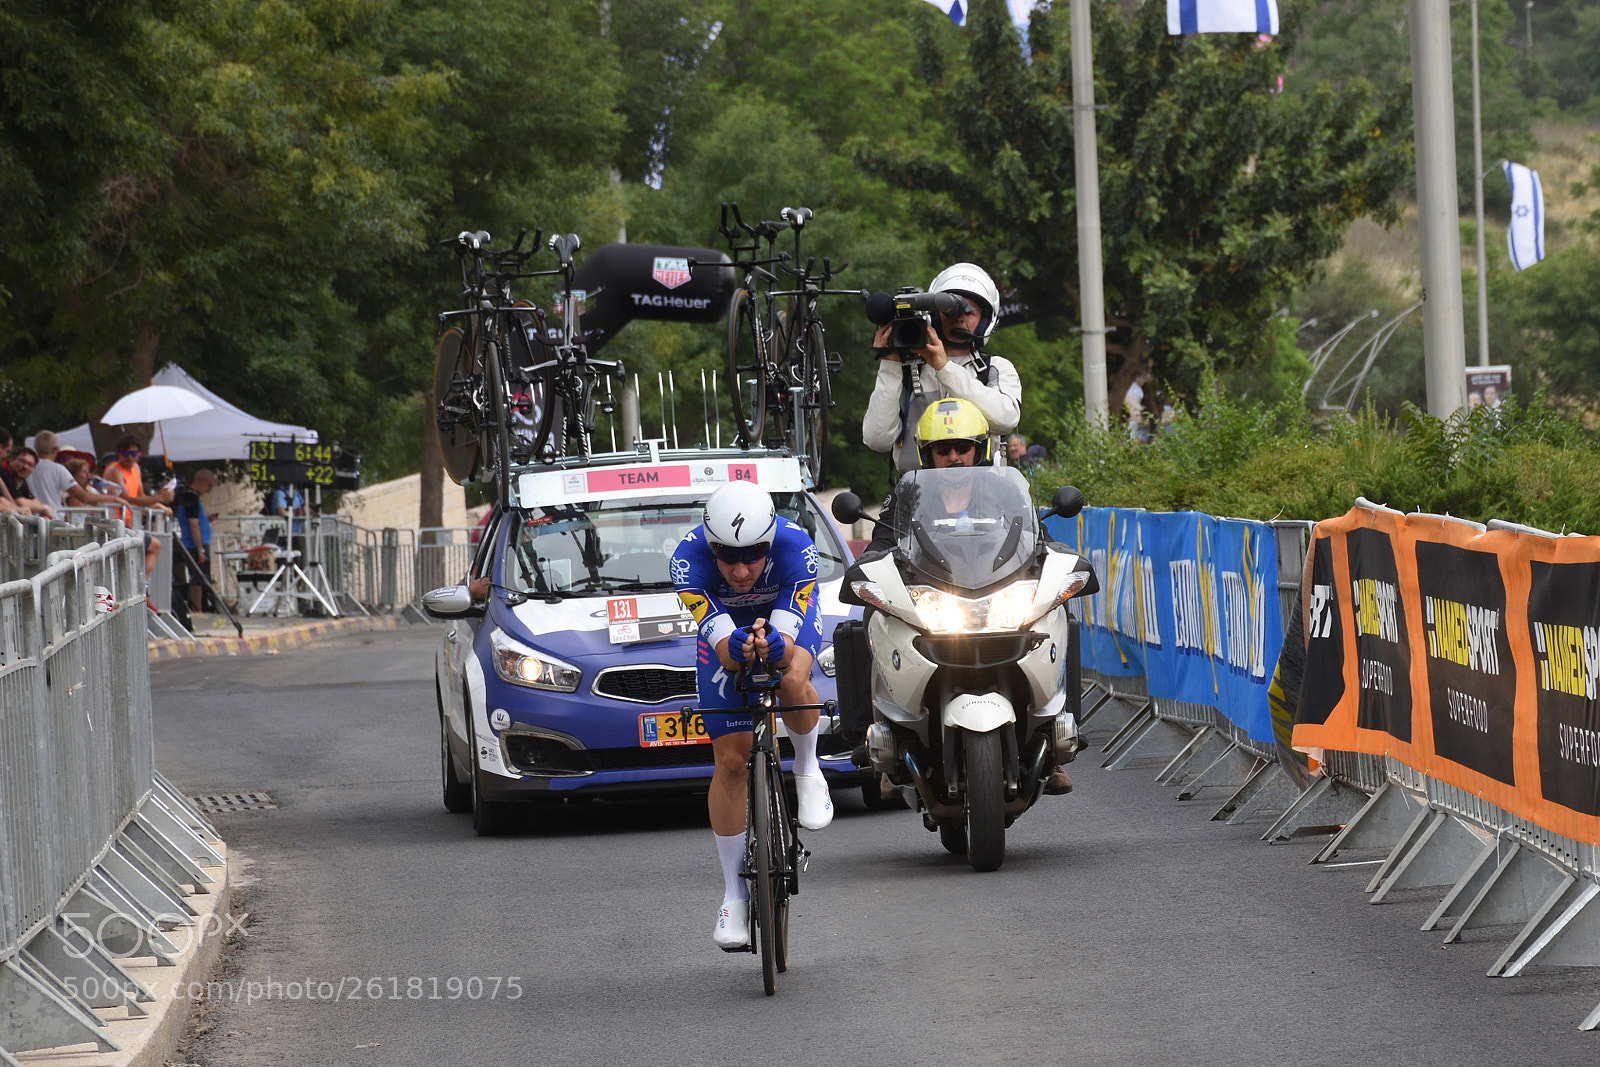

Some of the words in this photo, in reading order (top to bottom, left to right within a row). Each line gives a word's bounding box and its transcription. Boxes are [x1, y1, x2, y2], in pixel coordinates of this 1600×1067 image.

[251, 442, 276, 459] 131
[295, 444, 332, 461] 6:44
[305, 466, 334, 483] +22
[618, 471, 659, 485] TEAM
[735, 468, 751, 480] 84
[801, 546, 818, 574] PRO
[675, 559, 691, 585] PRO
[612, 600, 632, 619] 131
[1447, 686, 1489, 734] SUPERFOOD
[646, 723, 655, 734] IL
